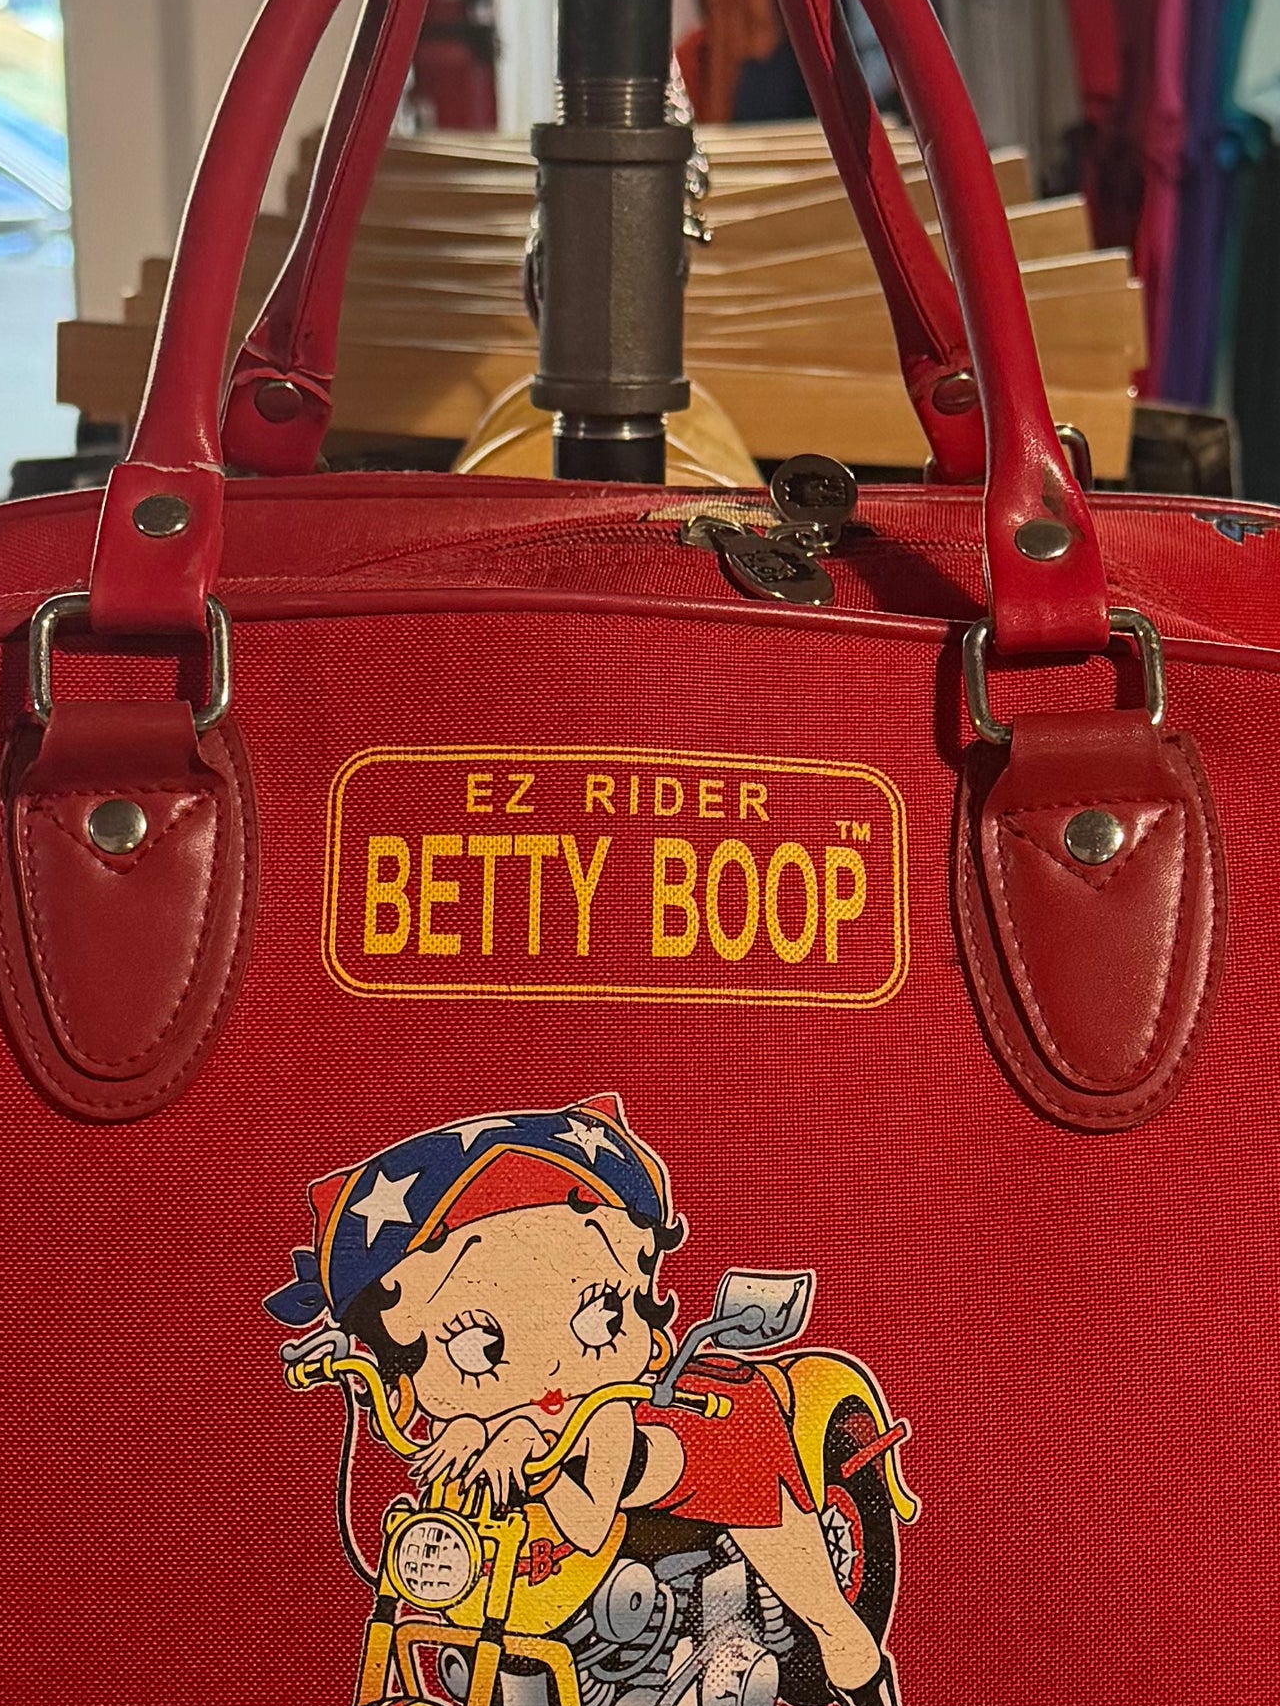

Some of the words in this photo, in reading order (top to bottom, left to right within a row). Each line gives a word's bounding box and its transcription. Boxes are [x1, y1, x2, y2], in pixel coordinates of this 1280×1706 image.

[466, 773, 535, 814] EZ
[585, 773, 770, 821] RIDER
[363, 834, 613, 957] BETTY
[651, 836, 867, 964] BOOP
